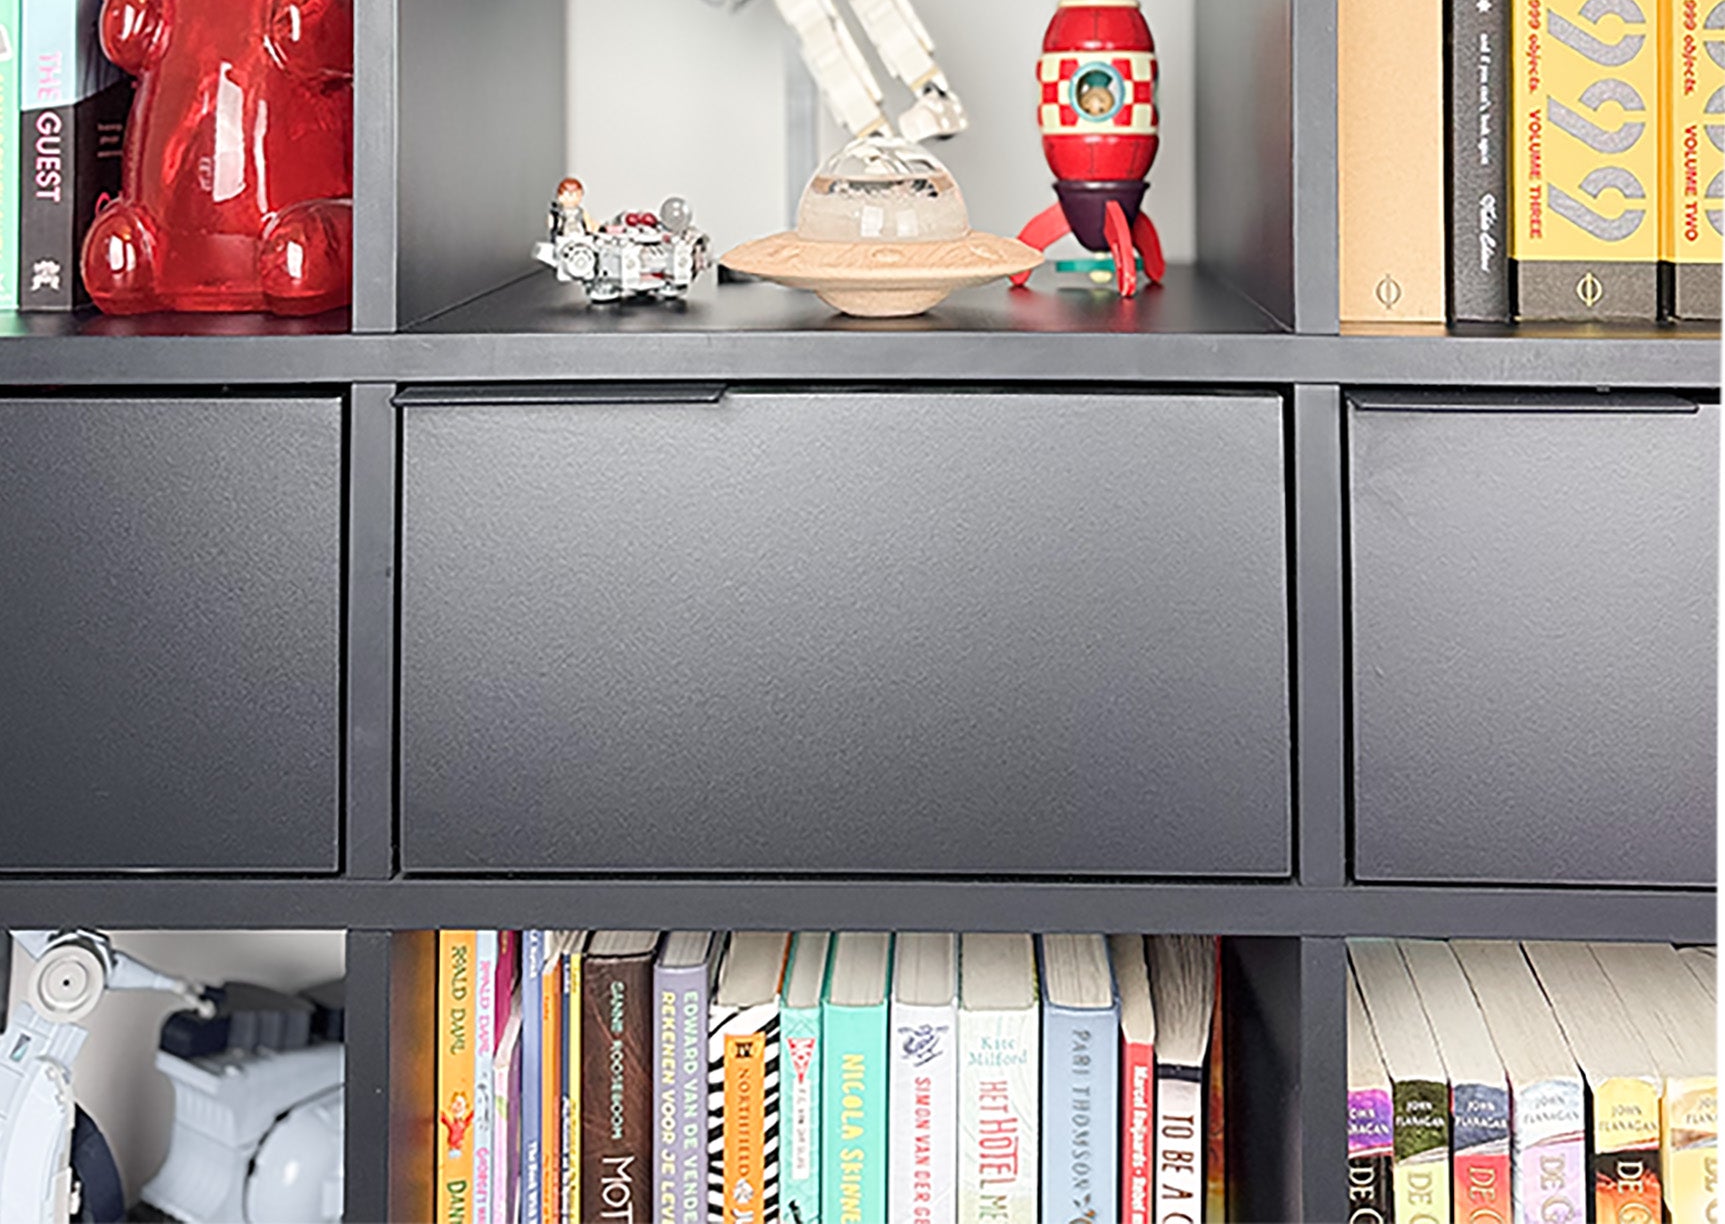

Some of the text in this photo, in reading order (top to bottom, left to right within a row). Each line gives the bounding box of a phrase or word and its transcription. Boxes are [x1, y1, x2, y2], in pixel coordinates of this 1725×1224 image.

[1683, 0, 1696, 30] 999
[36, 51, 63, 202] THE GUEST
[1529, 109, 1542, 180] VOLUME
[1684, 124, 1698, 197] VOLUME
[1529, 186, 1541, 239] THREE
[1684, 202, 1699, 242] TWO
[449, 945, 468, 1056] ROALD DAHL
[662, 991, 677, 1084] REKENEN
[684, 991, 699, 1074] EDWARD
[968, 1048, 1028, 1067] Milford
[610, 1039, 625, 1140] ROOSEBOOM
[683, 1079, 698, 1118] VAN
[840, 1053, 866, 1140] NICOLA
[914, 1077, 931, 1130] SIMON
[979, 1080, 1009, 1114] HET
[1406, 1100, 1434, 1113] JOHN
[1466, 1100, 1496, 1113] JOHN
[1534, 1093, 1567, 1110] JOHN
[661, 1087, 676, 1144] VOOR
[1072, 1029, 1092, 1190] PARI THOMSON
[1347, 1107, 1376, 1120] OHN
[1394, 1115, 1446, 1128] FLANAGAN
[1600, 1119, 1658, 1133] FLANAGAN
[1611, 1103, 1643, 1118] JOHN
[683, 1123, 698, 1150] DE
[1162, 1114, 1195, 1140] TO
[661, 1148, 676, 1175] JE
[914, 1134, 931, 1166] VAN
[979, 1116, 1019, 1189] HOTEL
[1162, 1149, 1195, 1175] BE
[913, 1170, 931, 1203] DER
[1348, 1167, 1375, 1201] DE
[1407, 1171, 1433, 1206] DE
[1469, 1166, 1496, 1202] DE
[1539, 1152, 1565, 1191] DE
[1616, 1160, 1644, 1194] DE
[1162, 1183, 1195, 1200] A
